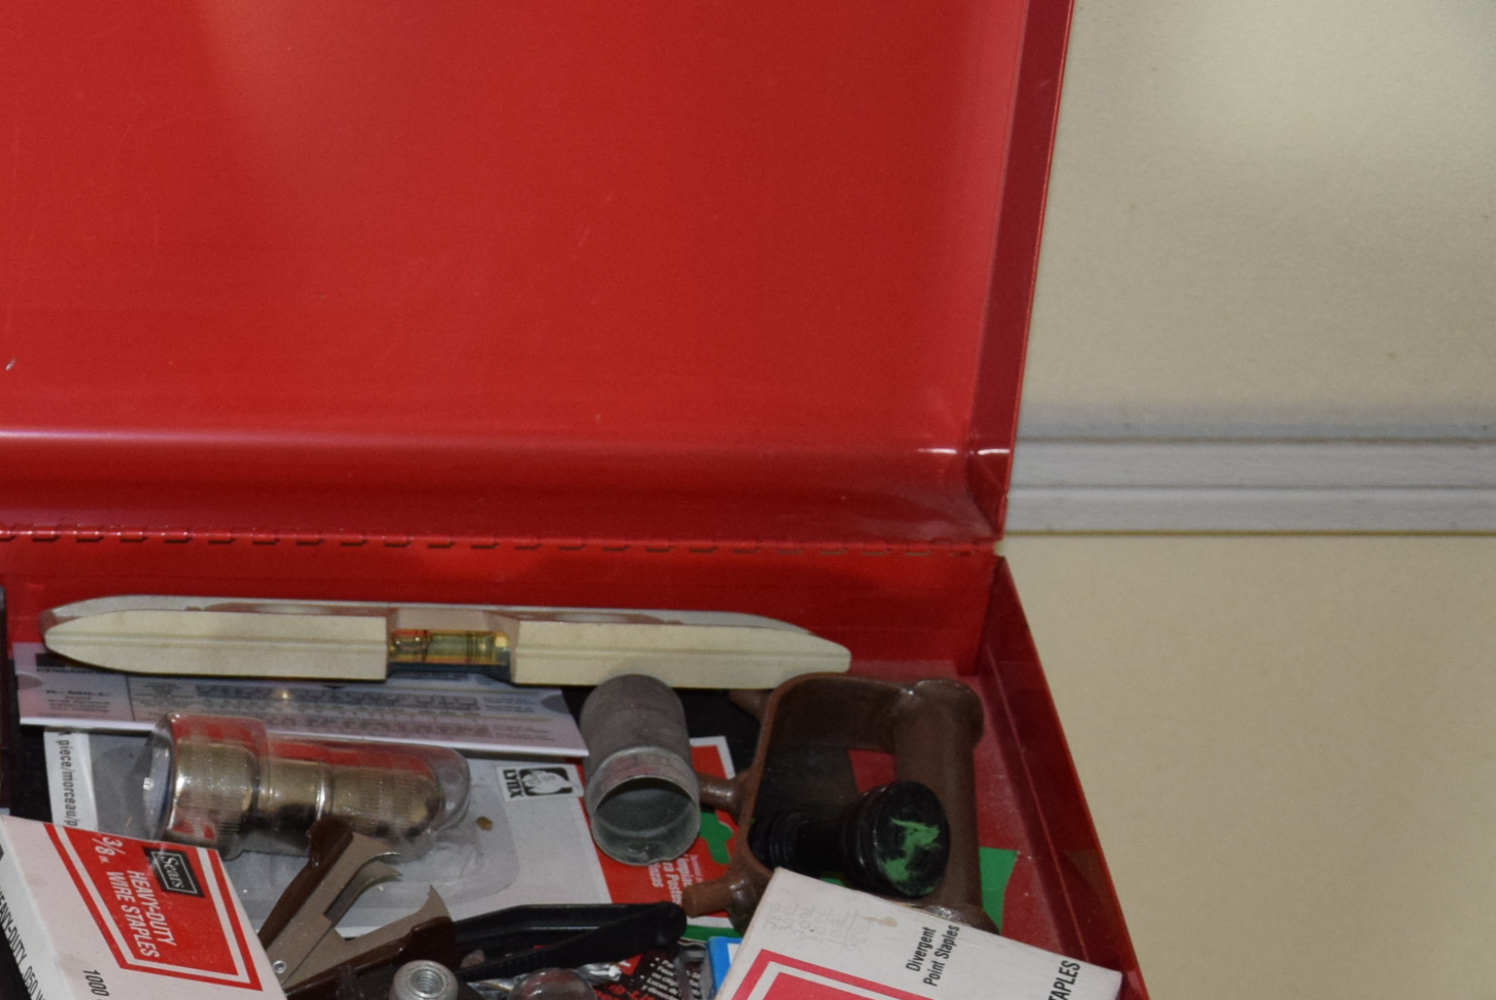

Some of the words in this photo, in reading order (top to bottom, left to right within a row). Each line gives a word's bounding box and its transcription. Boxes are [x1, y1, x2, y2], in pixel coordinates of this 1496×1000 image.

[106, 870, 134, 904] WIRE
[121, 903, 160, 959] STAPLES
[127, 869, 177, 947] HEAVY-DUTY
[904, 925, 936, 974] Divergent
[923, 952, 944, 988] Point
[935, 923, 961, 961] Staples
[83, 969, 110, 997] 1000
